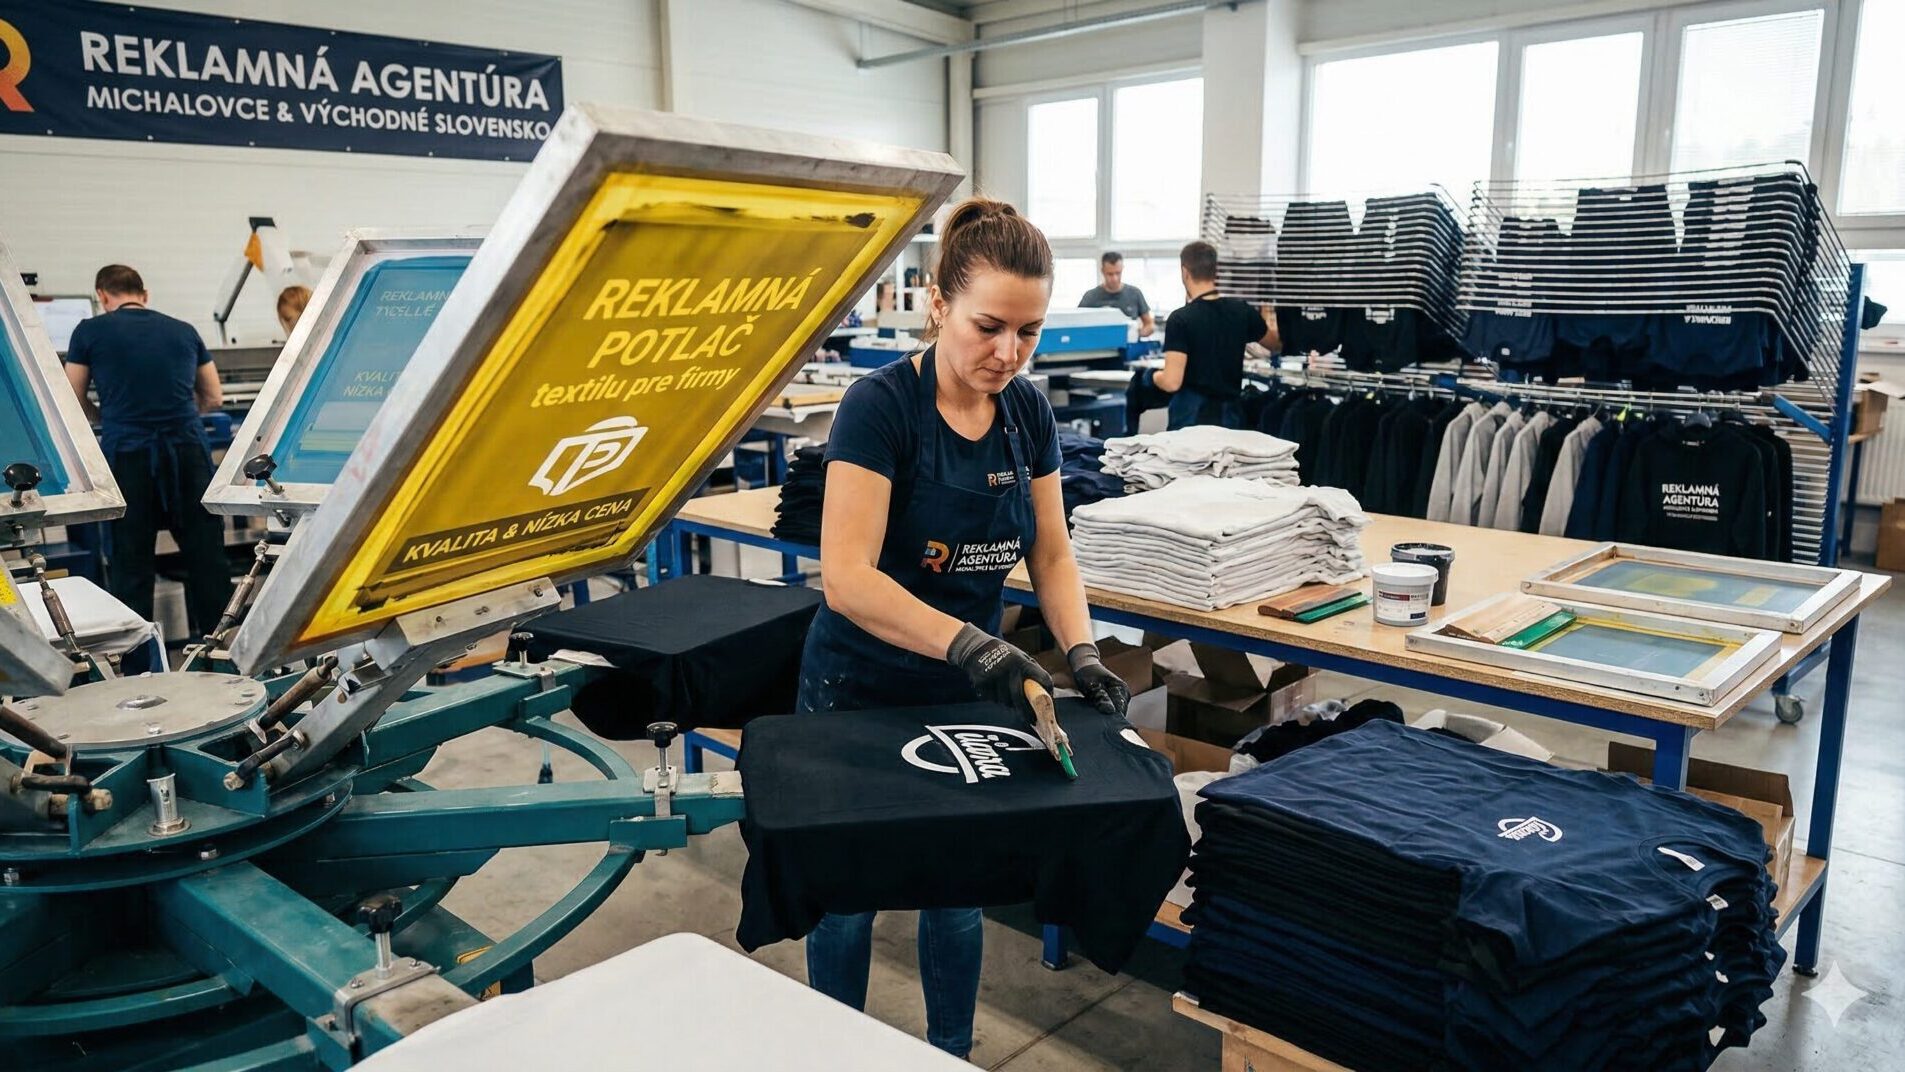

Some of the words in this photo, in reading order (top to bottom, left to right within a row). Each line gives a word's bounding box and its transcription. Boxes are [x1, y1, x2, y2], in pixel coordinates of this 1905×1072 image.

[80, 30, 339, 92] REKLAMNÁ
[350, 60, 550, 112] AGENTÚRA
[86, 85, 270, 122] MICHALOVCE
[276, 101, 295, 123] &
[299, 98, 429, 133] VÝCHODNÉ
[434, 112, 551, 141] SLOVENSKO
[380, 291, 451, 301] REKLAMN
[583, 267, 822, 320] REKLAMNÁ
[587, 314, 762, 368] POTLAČ
[530, 374, 627, 408] textilu
[622, 374, 674, 402] pre
[674, 366, 741, 391] firmy
[1662, 483, 1719, 496] REKLAMNÁ
[402, 528, 498, 563] KVALITA
[502, 523, 518, 540] &
[584, 497, 628, 521] CENA
[961, 536, 1021, 555] REKLAMNÁ
